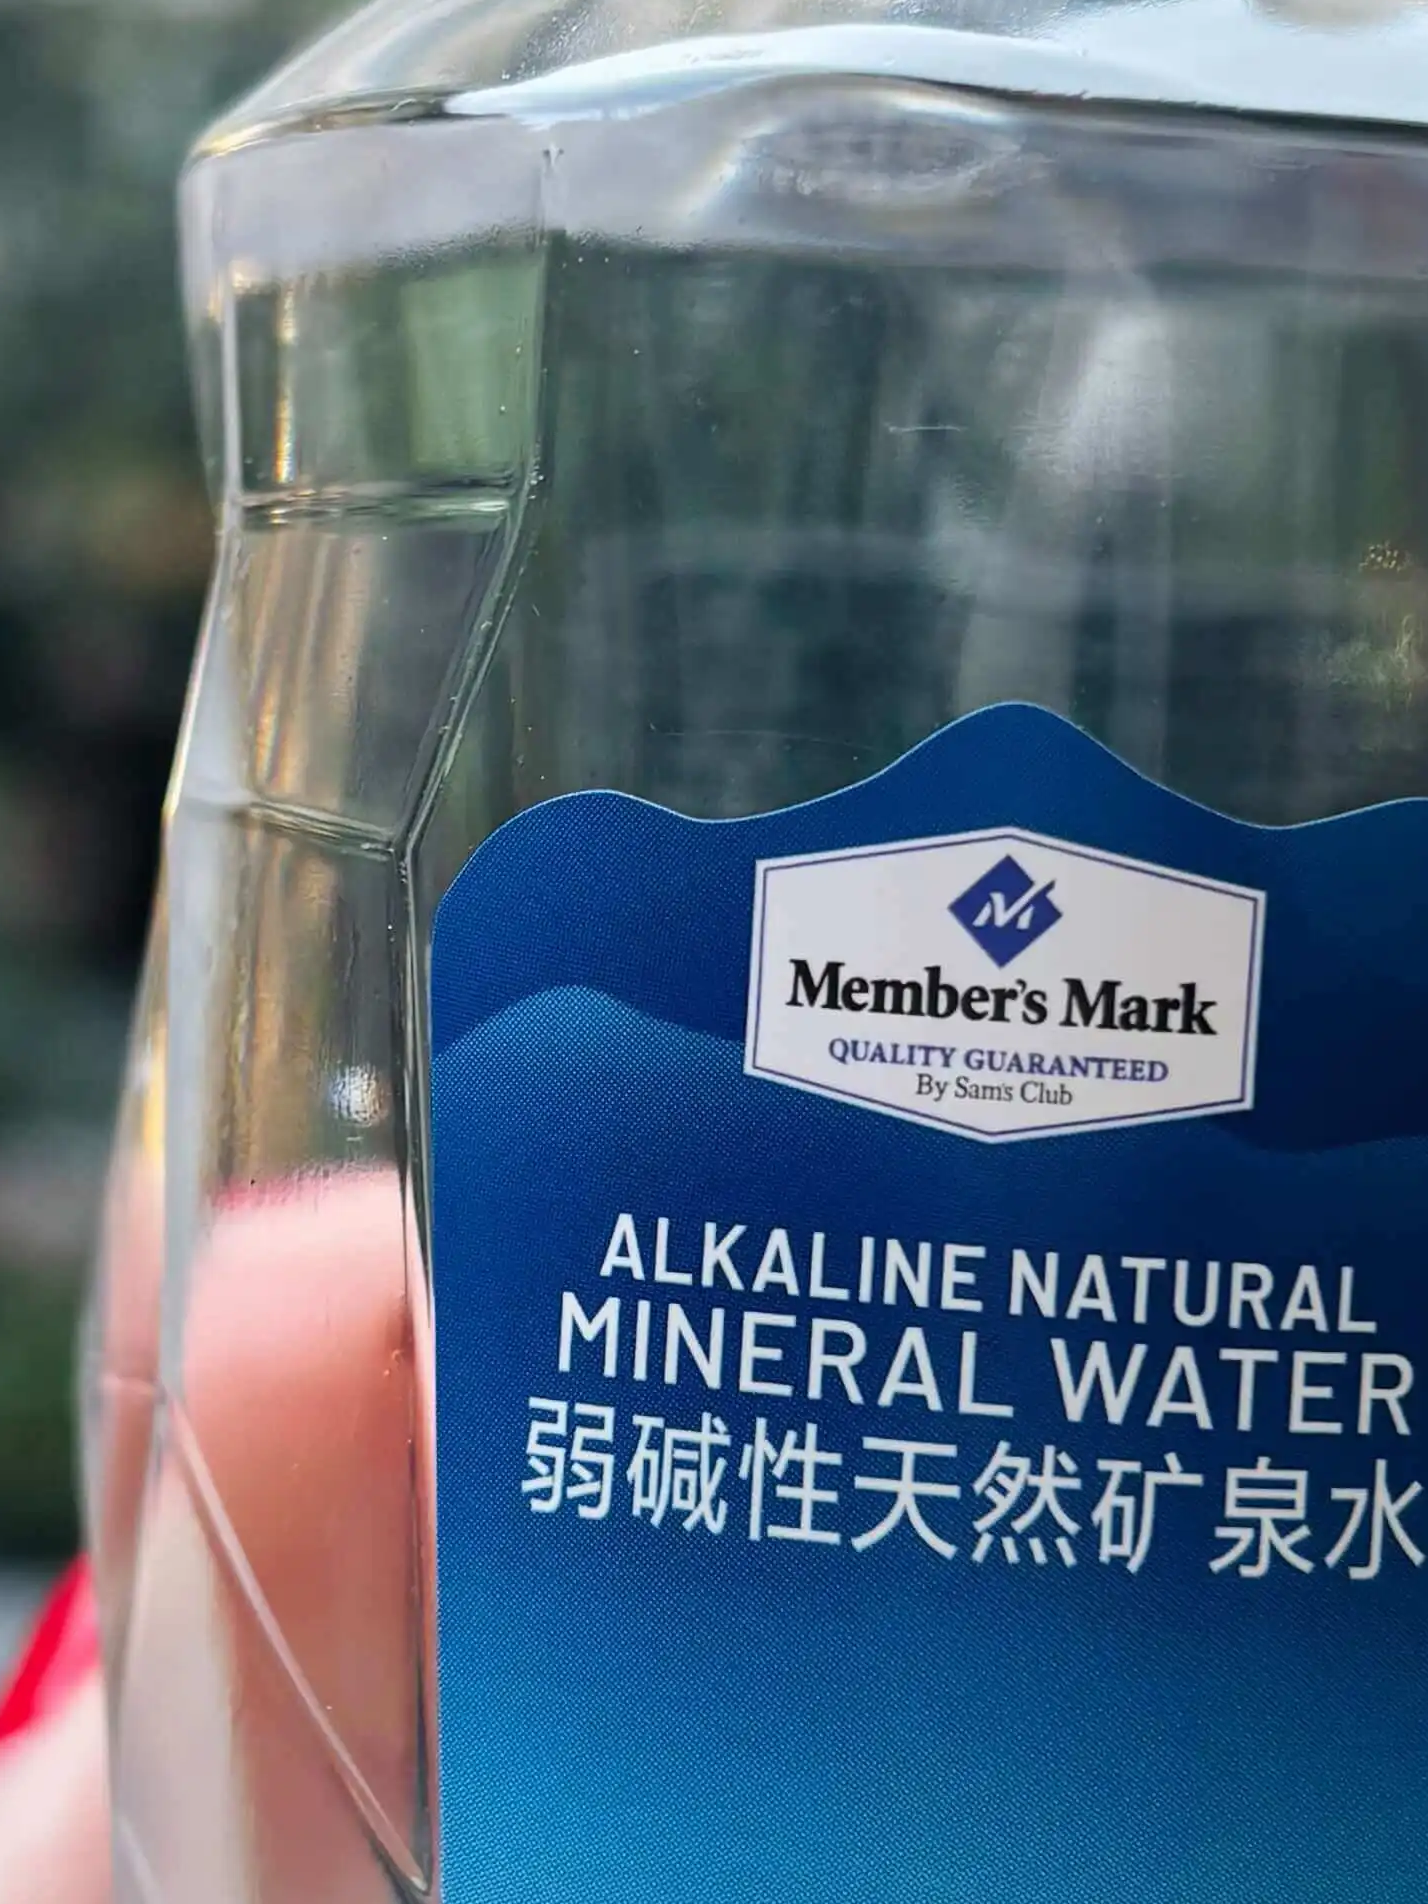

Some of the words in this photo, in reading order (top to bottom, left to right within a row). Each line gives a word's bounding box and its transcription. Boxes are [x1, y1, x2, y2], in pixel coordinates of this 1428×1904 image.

[786, 958, 1049, 1026] Member's
[1059, 977, 1218, 1036] Mark
[828, 1037, 956, 1072] QUALITY
[963, 1047, 1169, 1083] GUARANTEED
[915, 1072, 947, 1100] By
[953, 1077, 1014, 1102] Sam's
[1019, 1079, 1073, 1106] Club
[600, 1212, 987, 1312] ALKALINE
[1008, 1249, 1378, 1334] NATURAL
[558, 1291, 1015, 1418] MINERAL
[1050, 1338, 1416, 1436] WATER
[521, 1395, 1427, 1582] 弱碱性天然矿泉水
